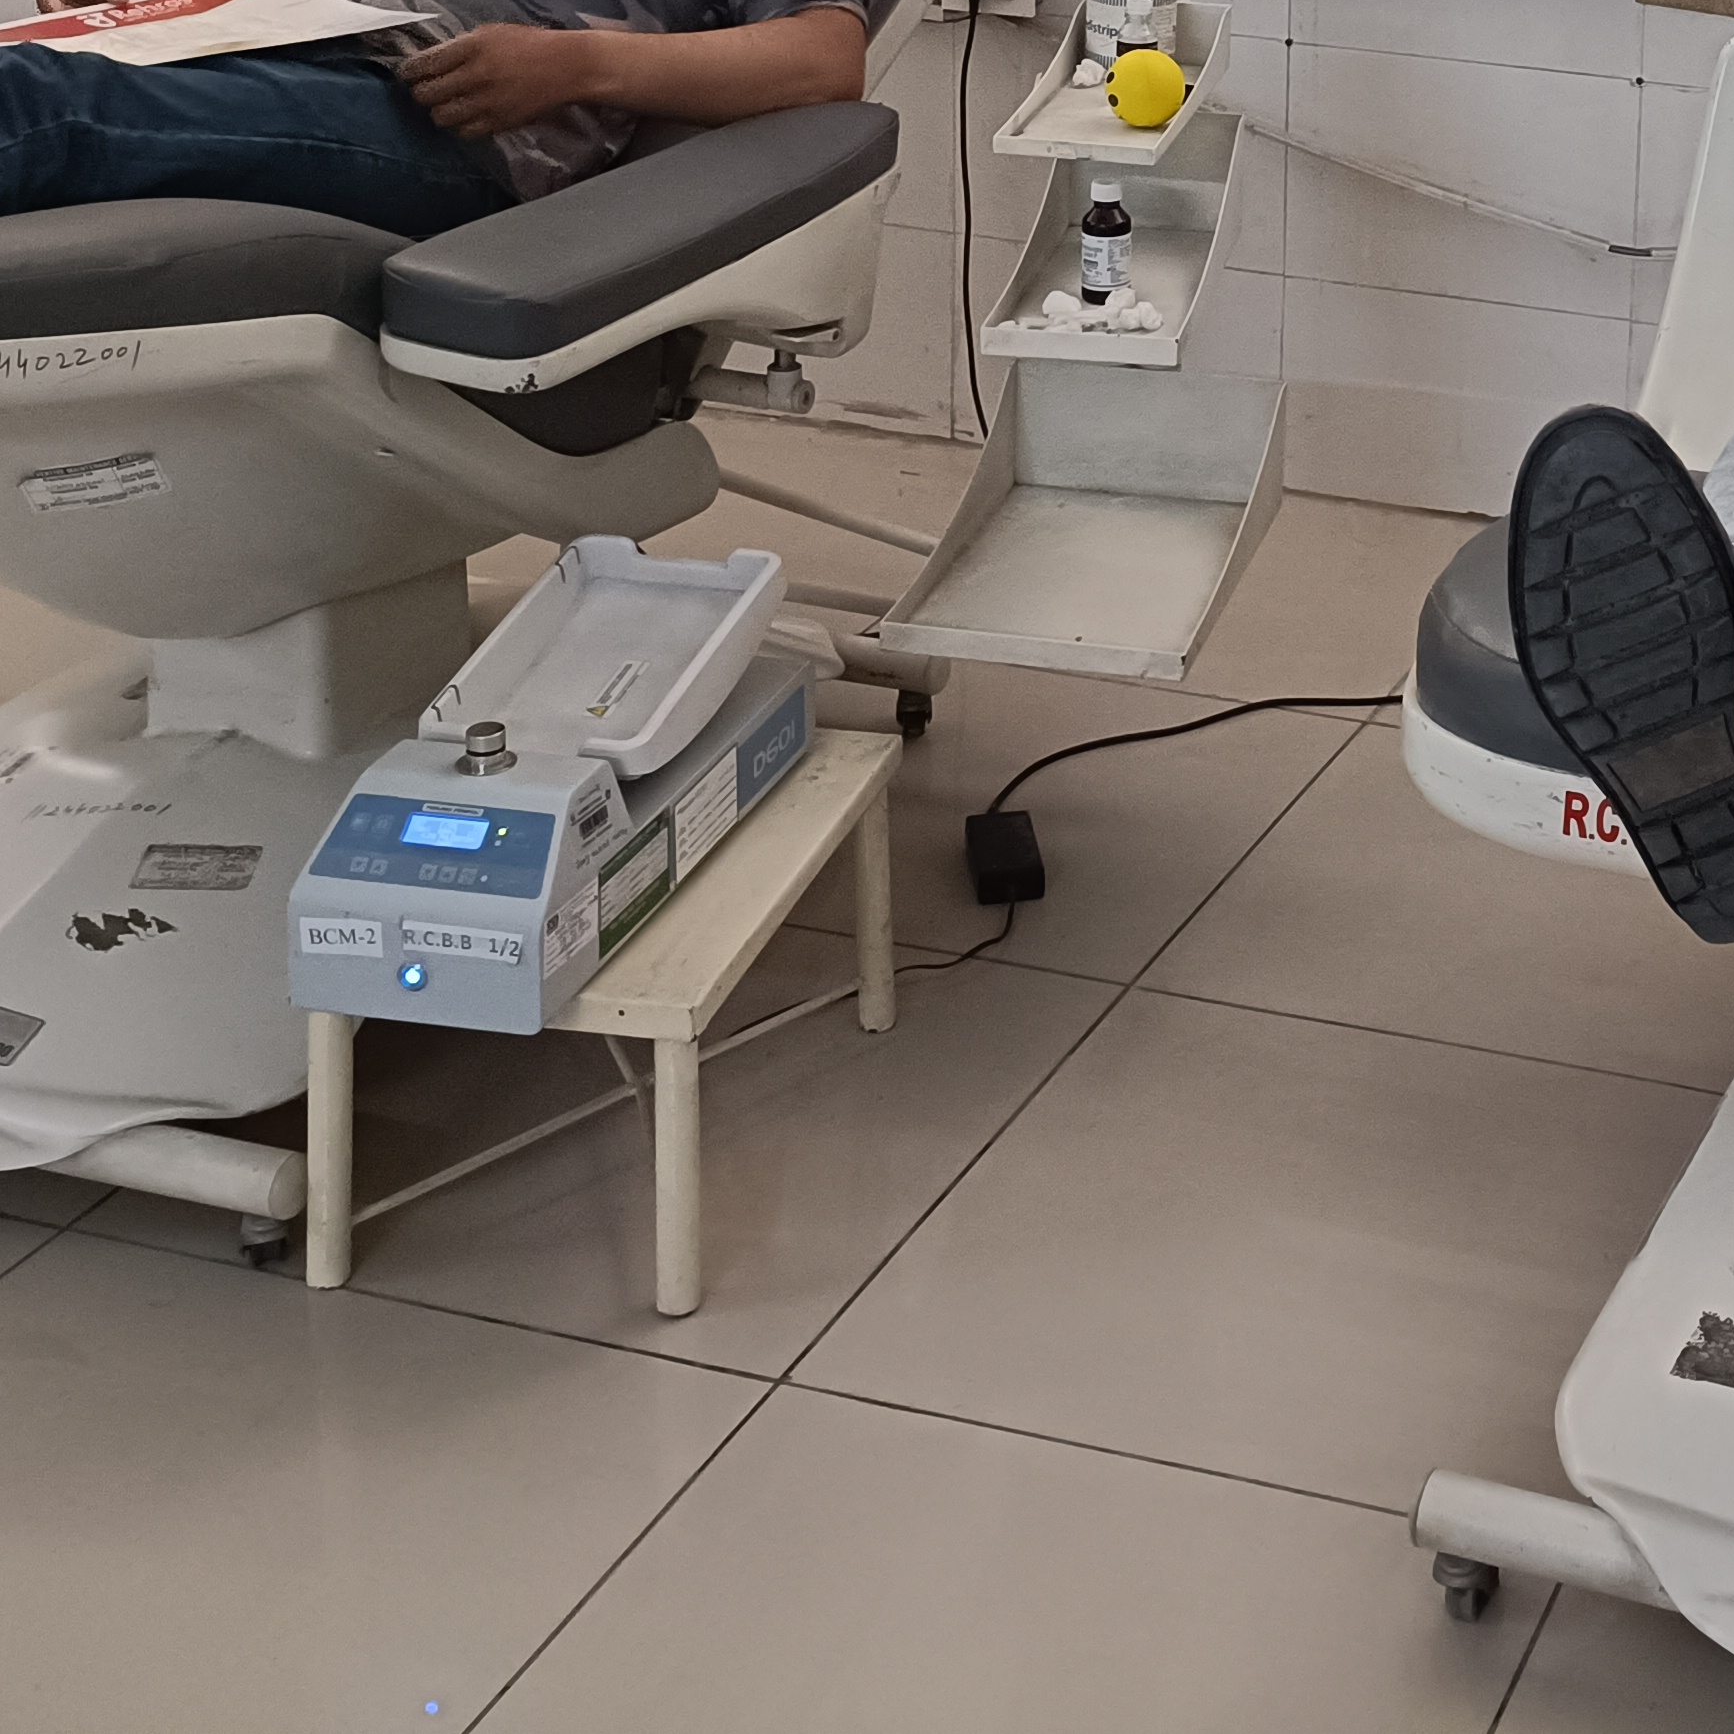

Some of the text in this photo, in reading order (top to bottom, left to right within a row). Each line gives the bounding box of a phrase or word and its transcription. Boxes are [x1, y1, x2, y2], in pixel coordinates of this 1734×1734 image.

[308, 927, 377, 946] BCM-2
[402, 930, 520, 958] R.C.B.B 1/2
